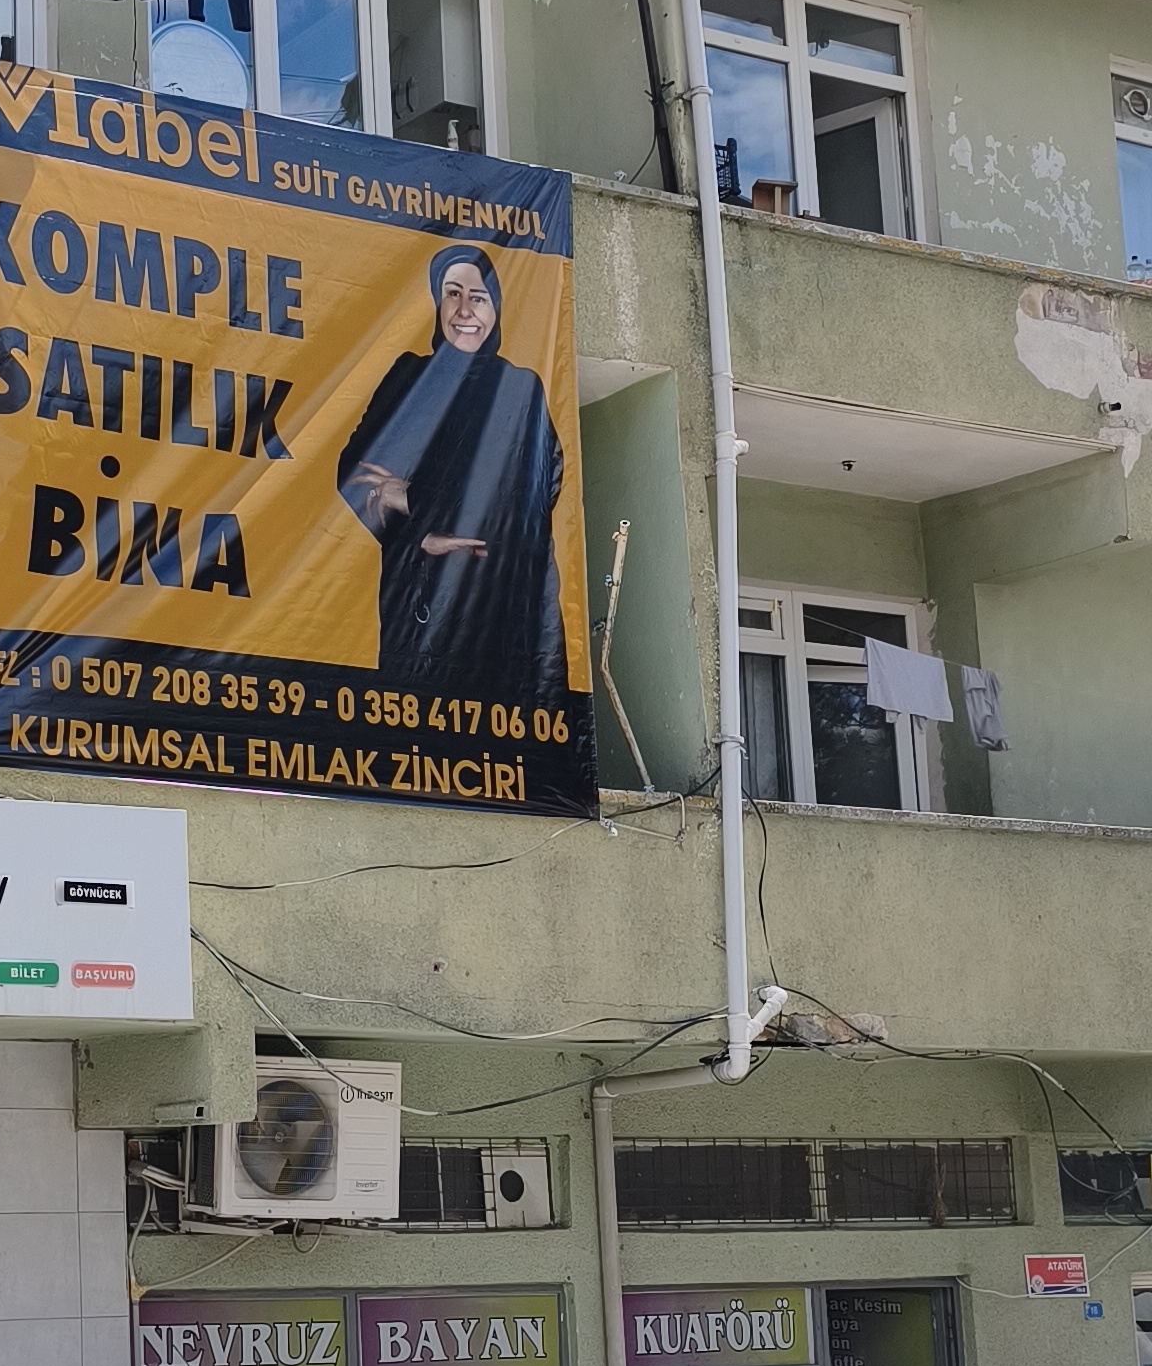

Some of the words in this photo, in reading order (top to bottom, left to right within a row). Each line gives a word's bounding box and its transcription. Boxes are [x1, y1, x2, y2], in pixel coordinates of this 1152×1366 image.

[273, 152, 339, 201] SUİT
[347, 174, 547, 241] GAYRİMENKUL
[27, 455, 252, 599] BİNA
[52, 655, 71, 690] 0
[82, 658, 139, 698] 507
[152, 665, 209, 706] 208
[220, 675, 258, 711] 35
[269, 679, 305, 716] 39
[337, 686, 354, 722] 0
[365, 691, 418, 728] 358
[429, 697, 481, 734] 417
[492, 703, 526, 740] 06
[534, 707, 568, 743] 06
[9, 714, 235, 775] KURUMSAL
[247, 734, 379, 789] EMLAK
[391, 745, 526, 801] ZİNCİRİ
[68, 884, 123, 901] GÖYNÜCEK
[10, 964, 46, 980] BİLET
[74, 967, 135, 984] BAŞVURU
[1048, 1259, 1083, 1272] ATATÜRK
[830, 1299, 848, 1314] aç
[854, 1298, 902, 1313] Kesim
[376, 1317, 547, 1365] BAYAN
[633, 1297, 796, 1355] KUAFÖRÜ
[831, 1319, 859, 1333] oya
[831, 1335, 850, 1350] ön
